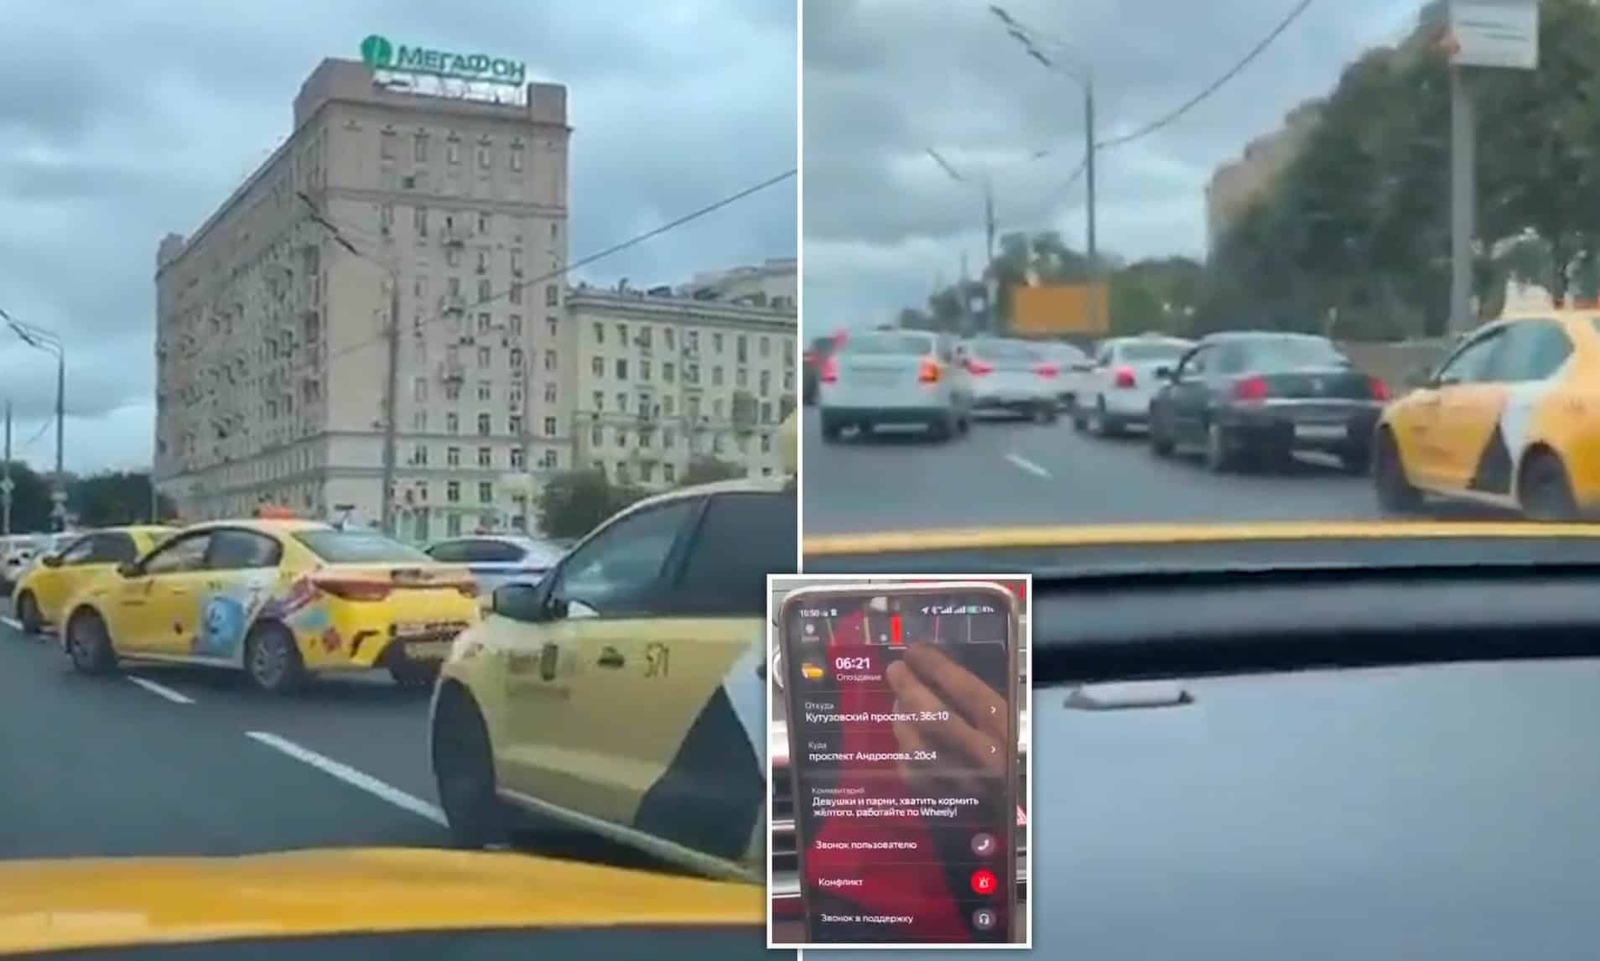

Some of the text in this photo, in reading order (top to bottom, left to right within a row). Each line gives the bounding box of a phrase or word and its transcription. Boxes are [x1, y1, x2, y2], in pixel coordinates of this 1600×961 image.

[835, 657, 871, 670] 06:21
[836, 673, 882, 683] Опоздание
[805, 701, 835, 711] Откуда
[805, 712, 869, 723] Кутузовский
[808, 741, 827, 751] Куда
[809, 752, 853, 762] проспект
[812, 786, 865, 795] Комментарий
[812, 797, 857, 808] Девушки
[899, 797, 937, 806] хватить
[938, 797, 979, 807] кормить
[856, 807, 905, 817] работайте
[906, 809, 919, 817] по
[815, 840, 917, 850] Звонок пользователю
[818, 876, 863, 888] Конфликт
[821, 913, 853, 923] Звонок
[863, 914, 914, 925] поддержку
